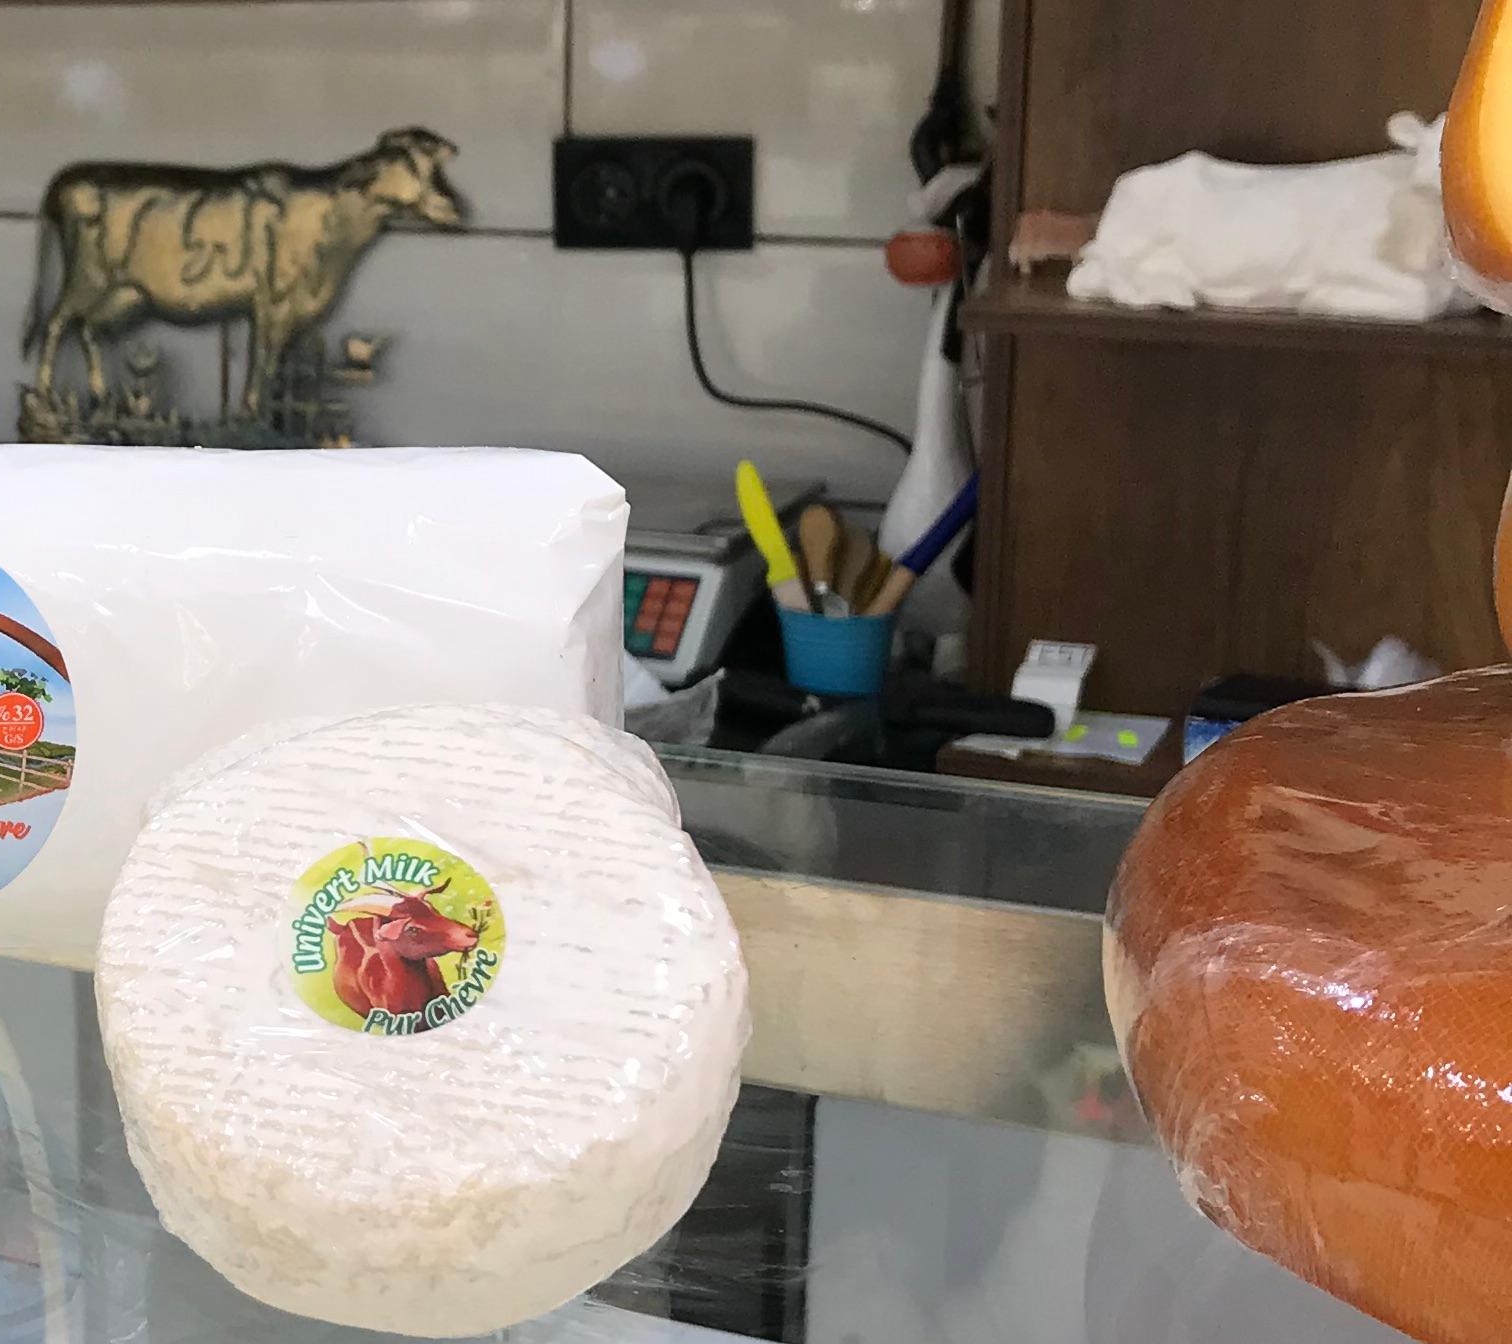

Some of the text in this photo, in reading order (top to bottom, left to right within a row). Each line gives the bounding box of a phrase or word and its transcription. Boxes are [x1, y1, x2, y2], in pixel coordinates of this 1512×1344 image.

[292, 853, 440, 974] Univert Milk
[362, 1008, 423, 1035] Pur
